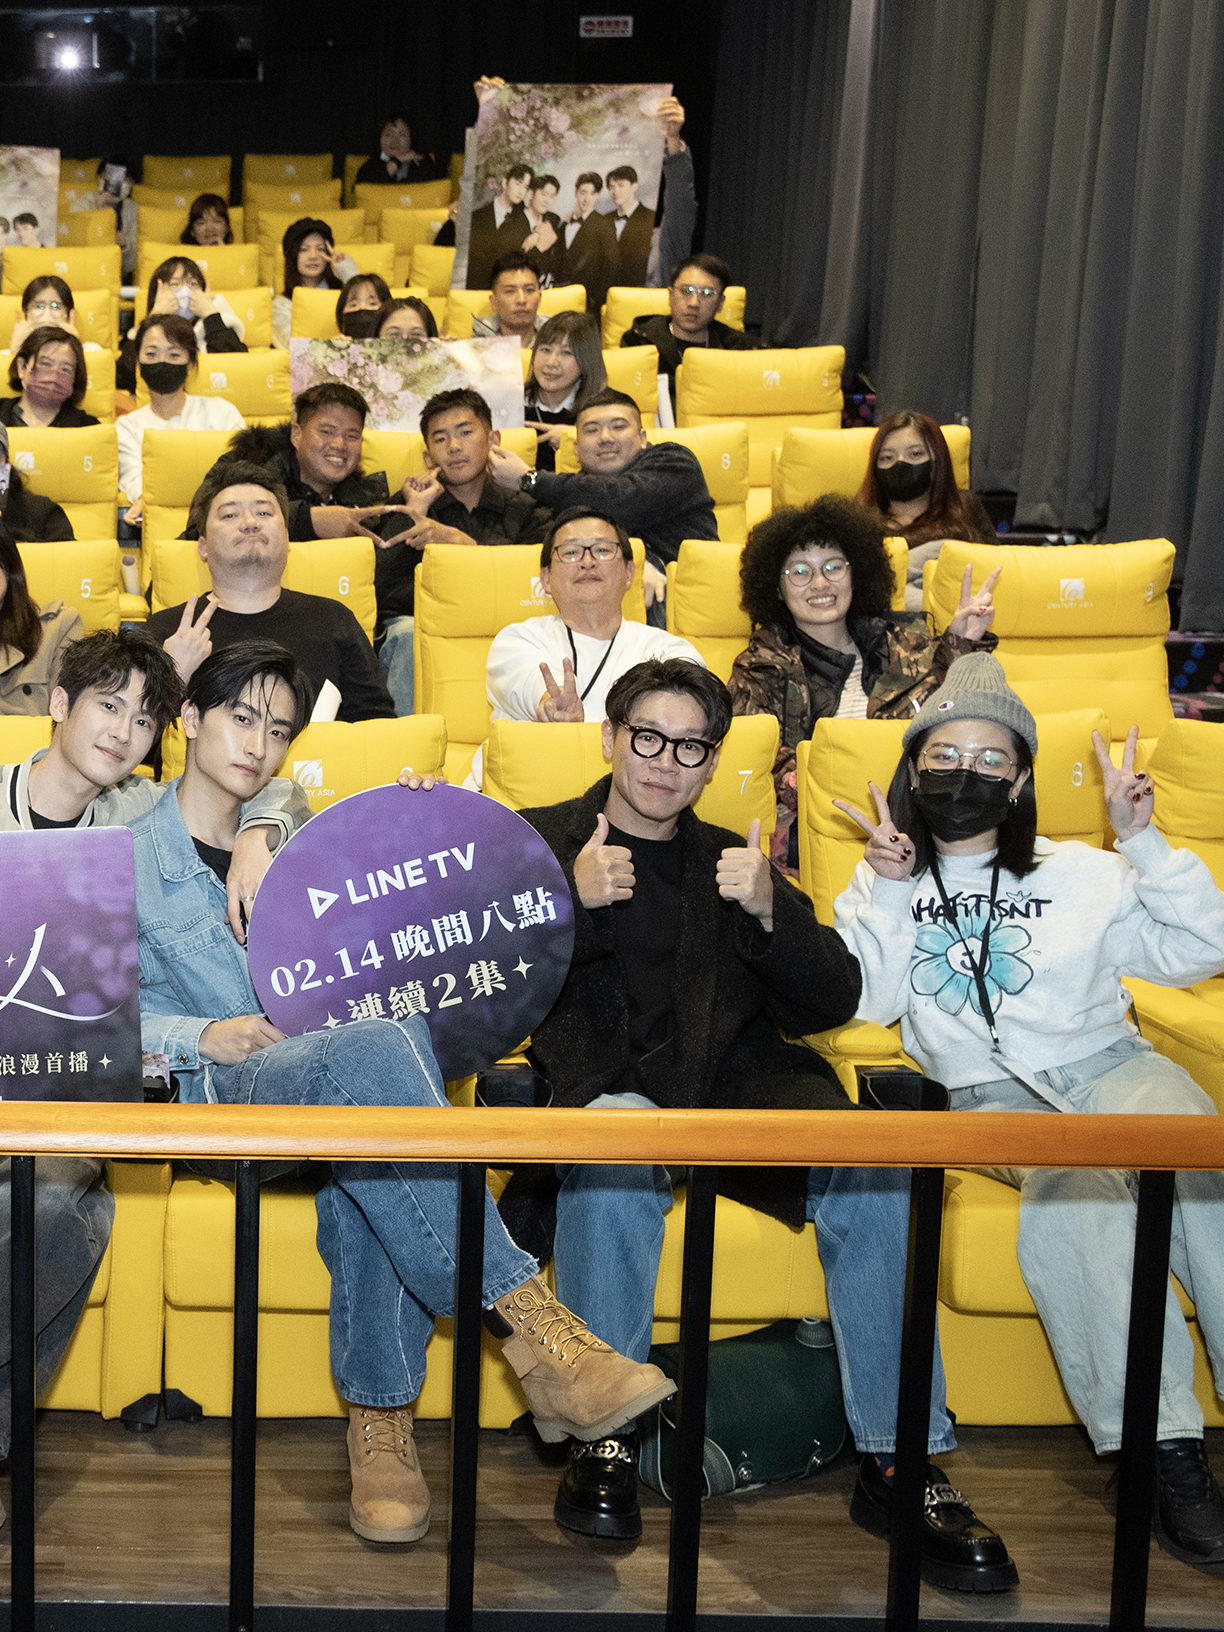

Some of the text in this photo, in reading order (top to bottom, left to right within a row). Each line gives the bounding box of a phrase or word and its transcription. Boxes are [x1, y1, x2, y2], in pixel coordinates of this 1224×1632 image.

[247, 309, 254, 321] 6
[266, 374, 274, 389] 6
[83, 455, 93, 473] 5
[721, 453, 731, 470] 8
[80, 579, 92, 598] 5
[338, 575, 349, 595] 6
[1145, 582, 1154, 602] 9
[738, 769, 753, 794] 7
[1072, 761, 1084, 787] 8
[317, 788, 335, 797] ASIA
[345, 842, 475, 905] LINE TV
[270, 886, 557, 997] 02.14 晚間八點
